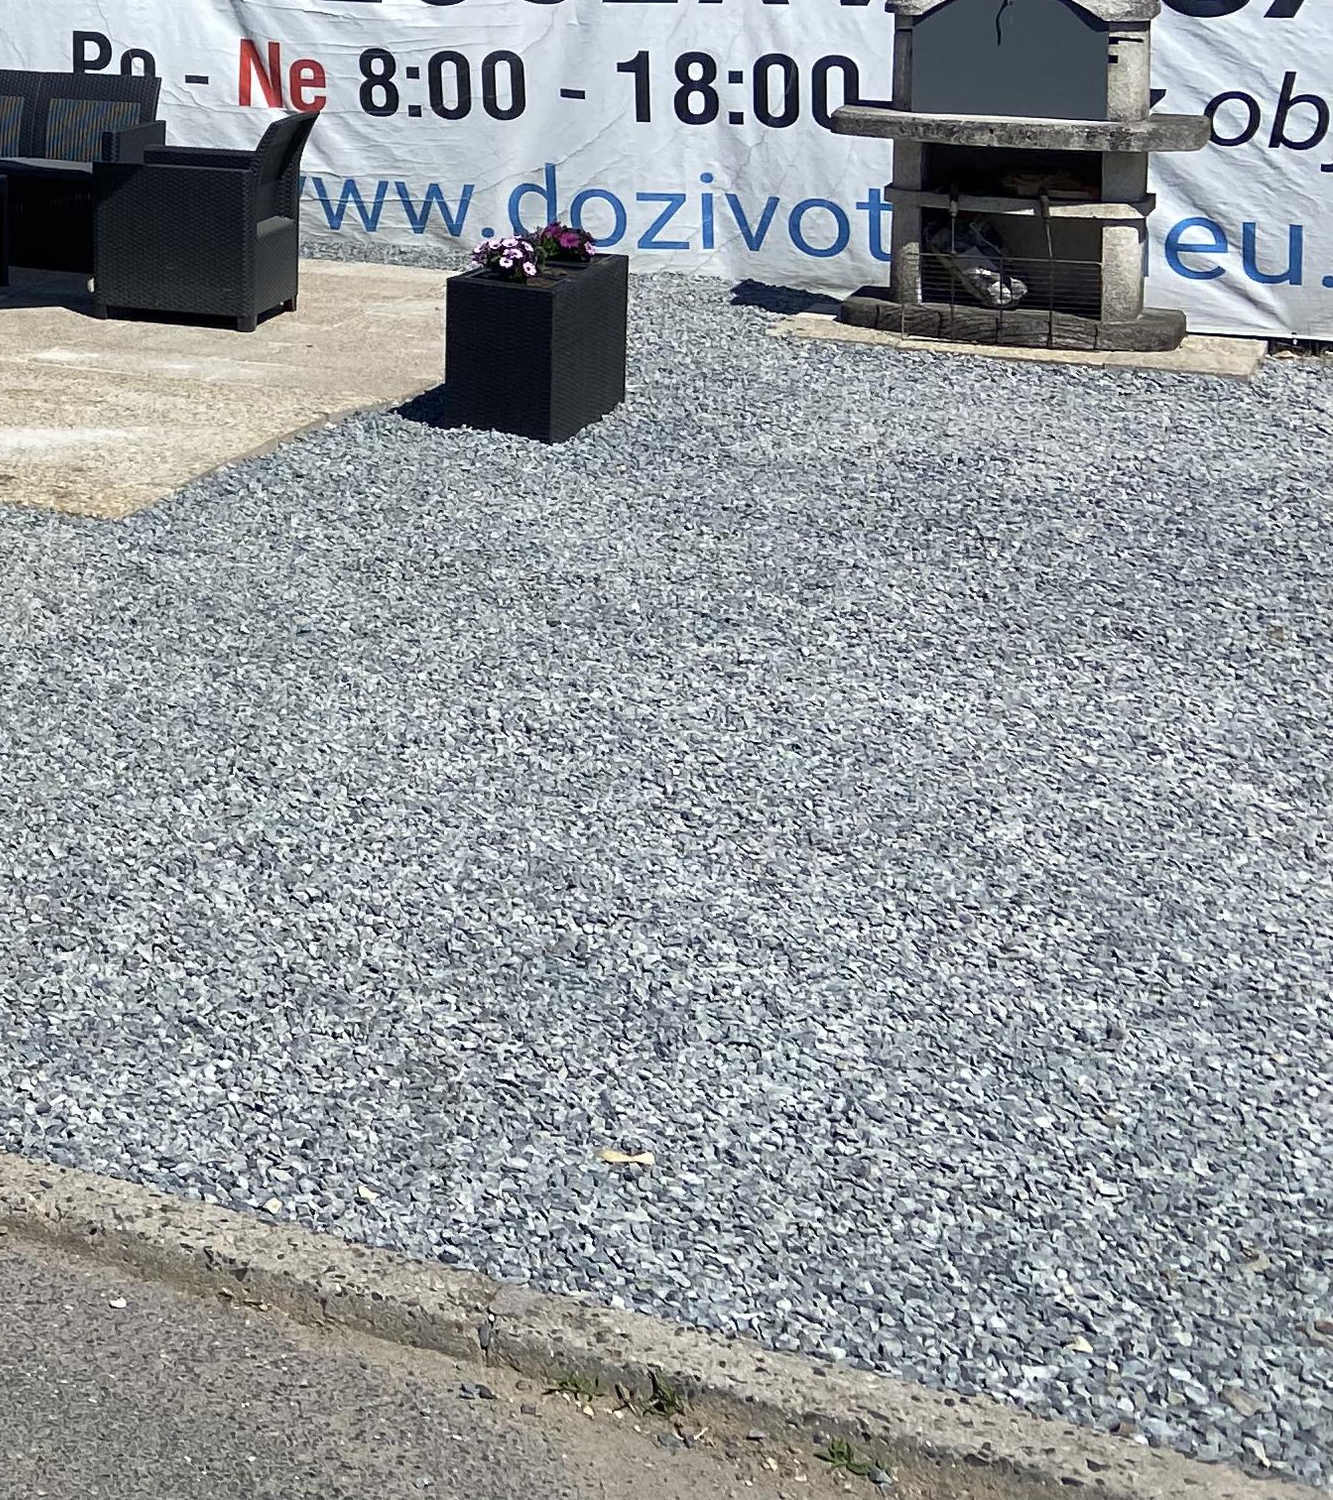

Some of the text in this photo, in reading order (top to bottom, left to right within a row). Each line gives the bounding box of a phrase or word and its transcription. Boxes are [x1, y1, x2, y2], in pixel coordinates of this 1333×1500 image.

[239, 39, 327, 113] Ne
[359, 47, 526, 121] 8:00
[616, 50, 860, 130] 18:00
[1203, 71, 1333, 173] ob
